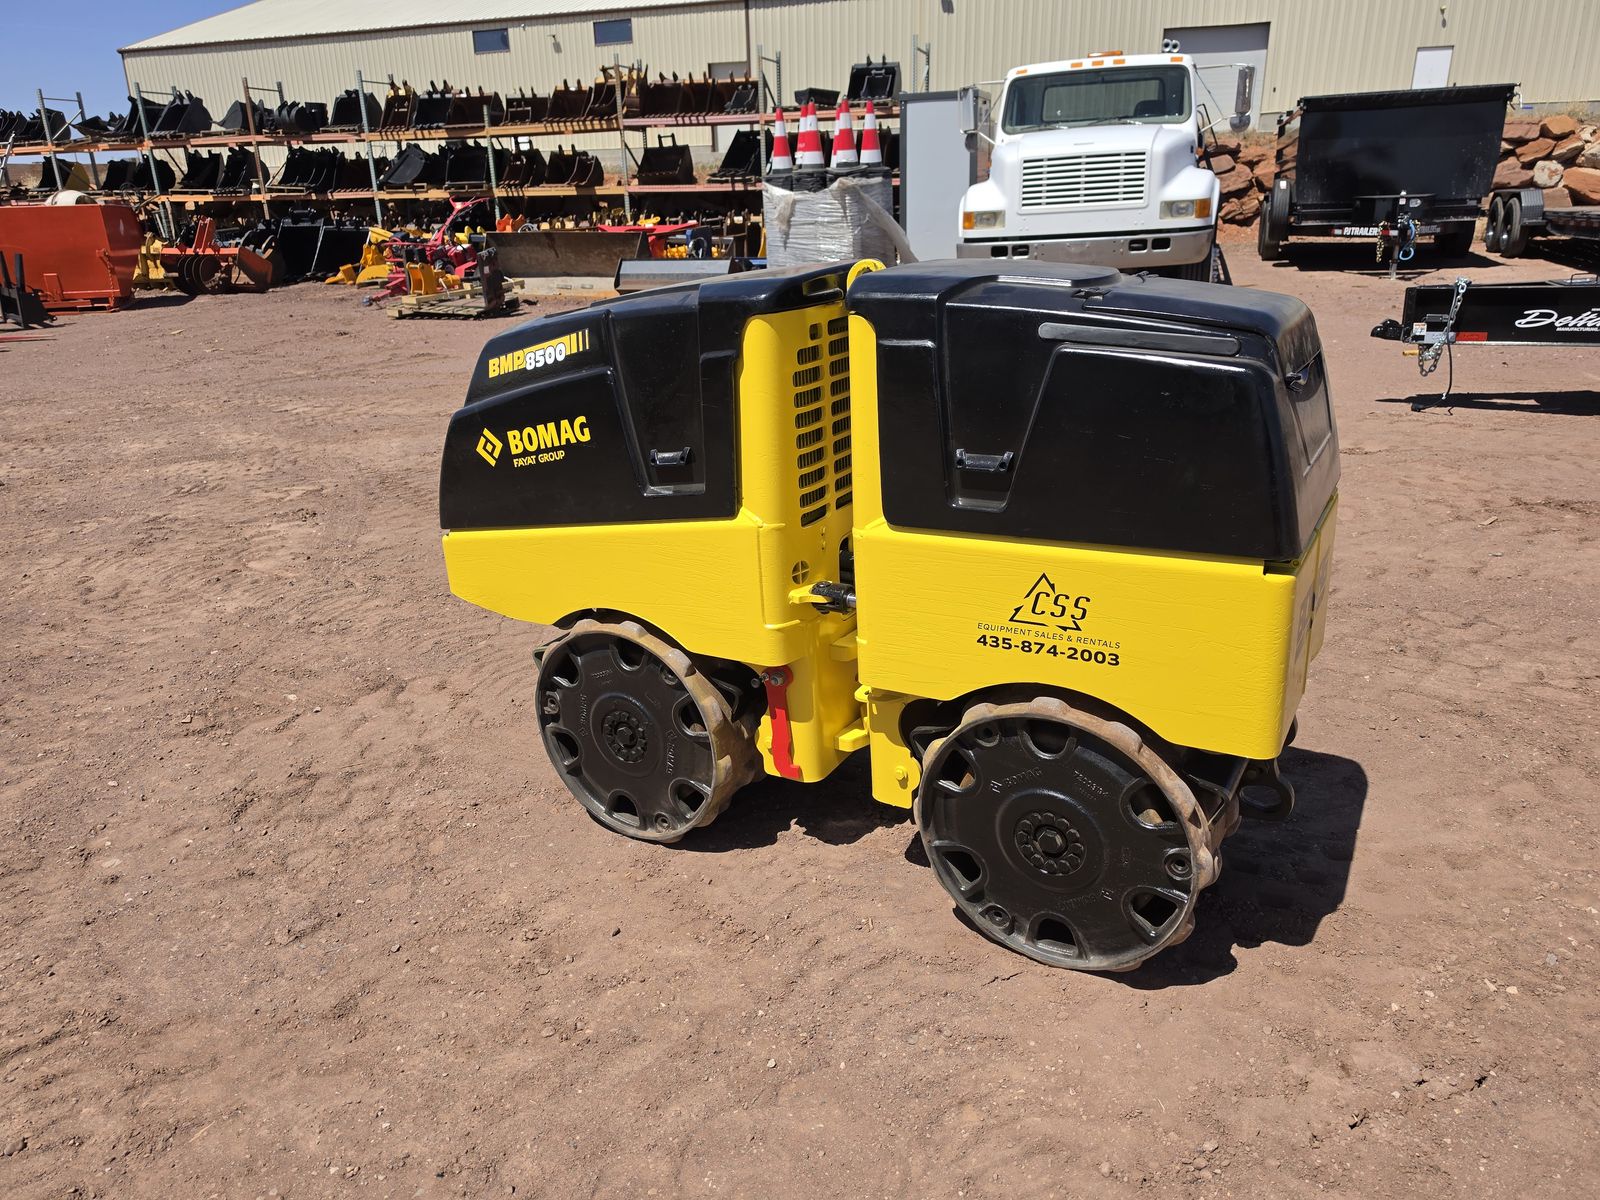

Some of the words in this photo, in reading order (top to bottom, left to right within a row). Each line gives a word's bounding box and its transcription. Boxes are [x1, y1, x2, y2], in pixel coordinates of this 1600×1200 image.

[507, 415, 591, 455] BOMAG
[513, 455, 537, 468] FAYAT
[538, 450, 566, 463] GROUP
[1031, 591, 1091, 620] CSS
[976, 634, 1120, 666] 435-874-2003
[977, 622, 1032, 637] EQUIPMENT
[1034, 630, 1064, 641] SALES
[1076, 636, 1121, 649] RENTALS
